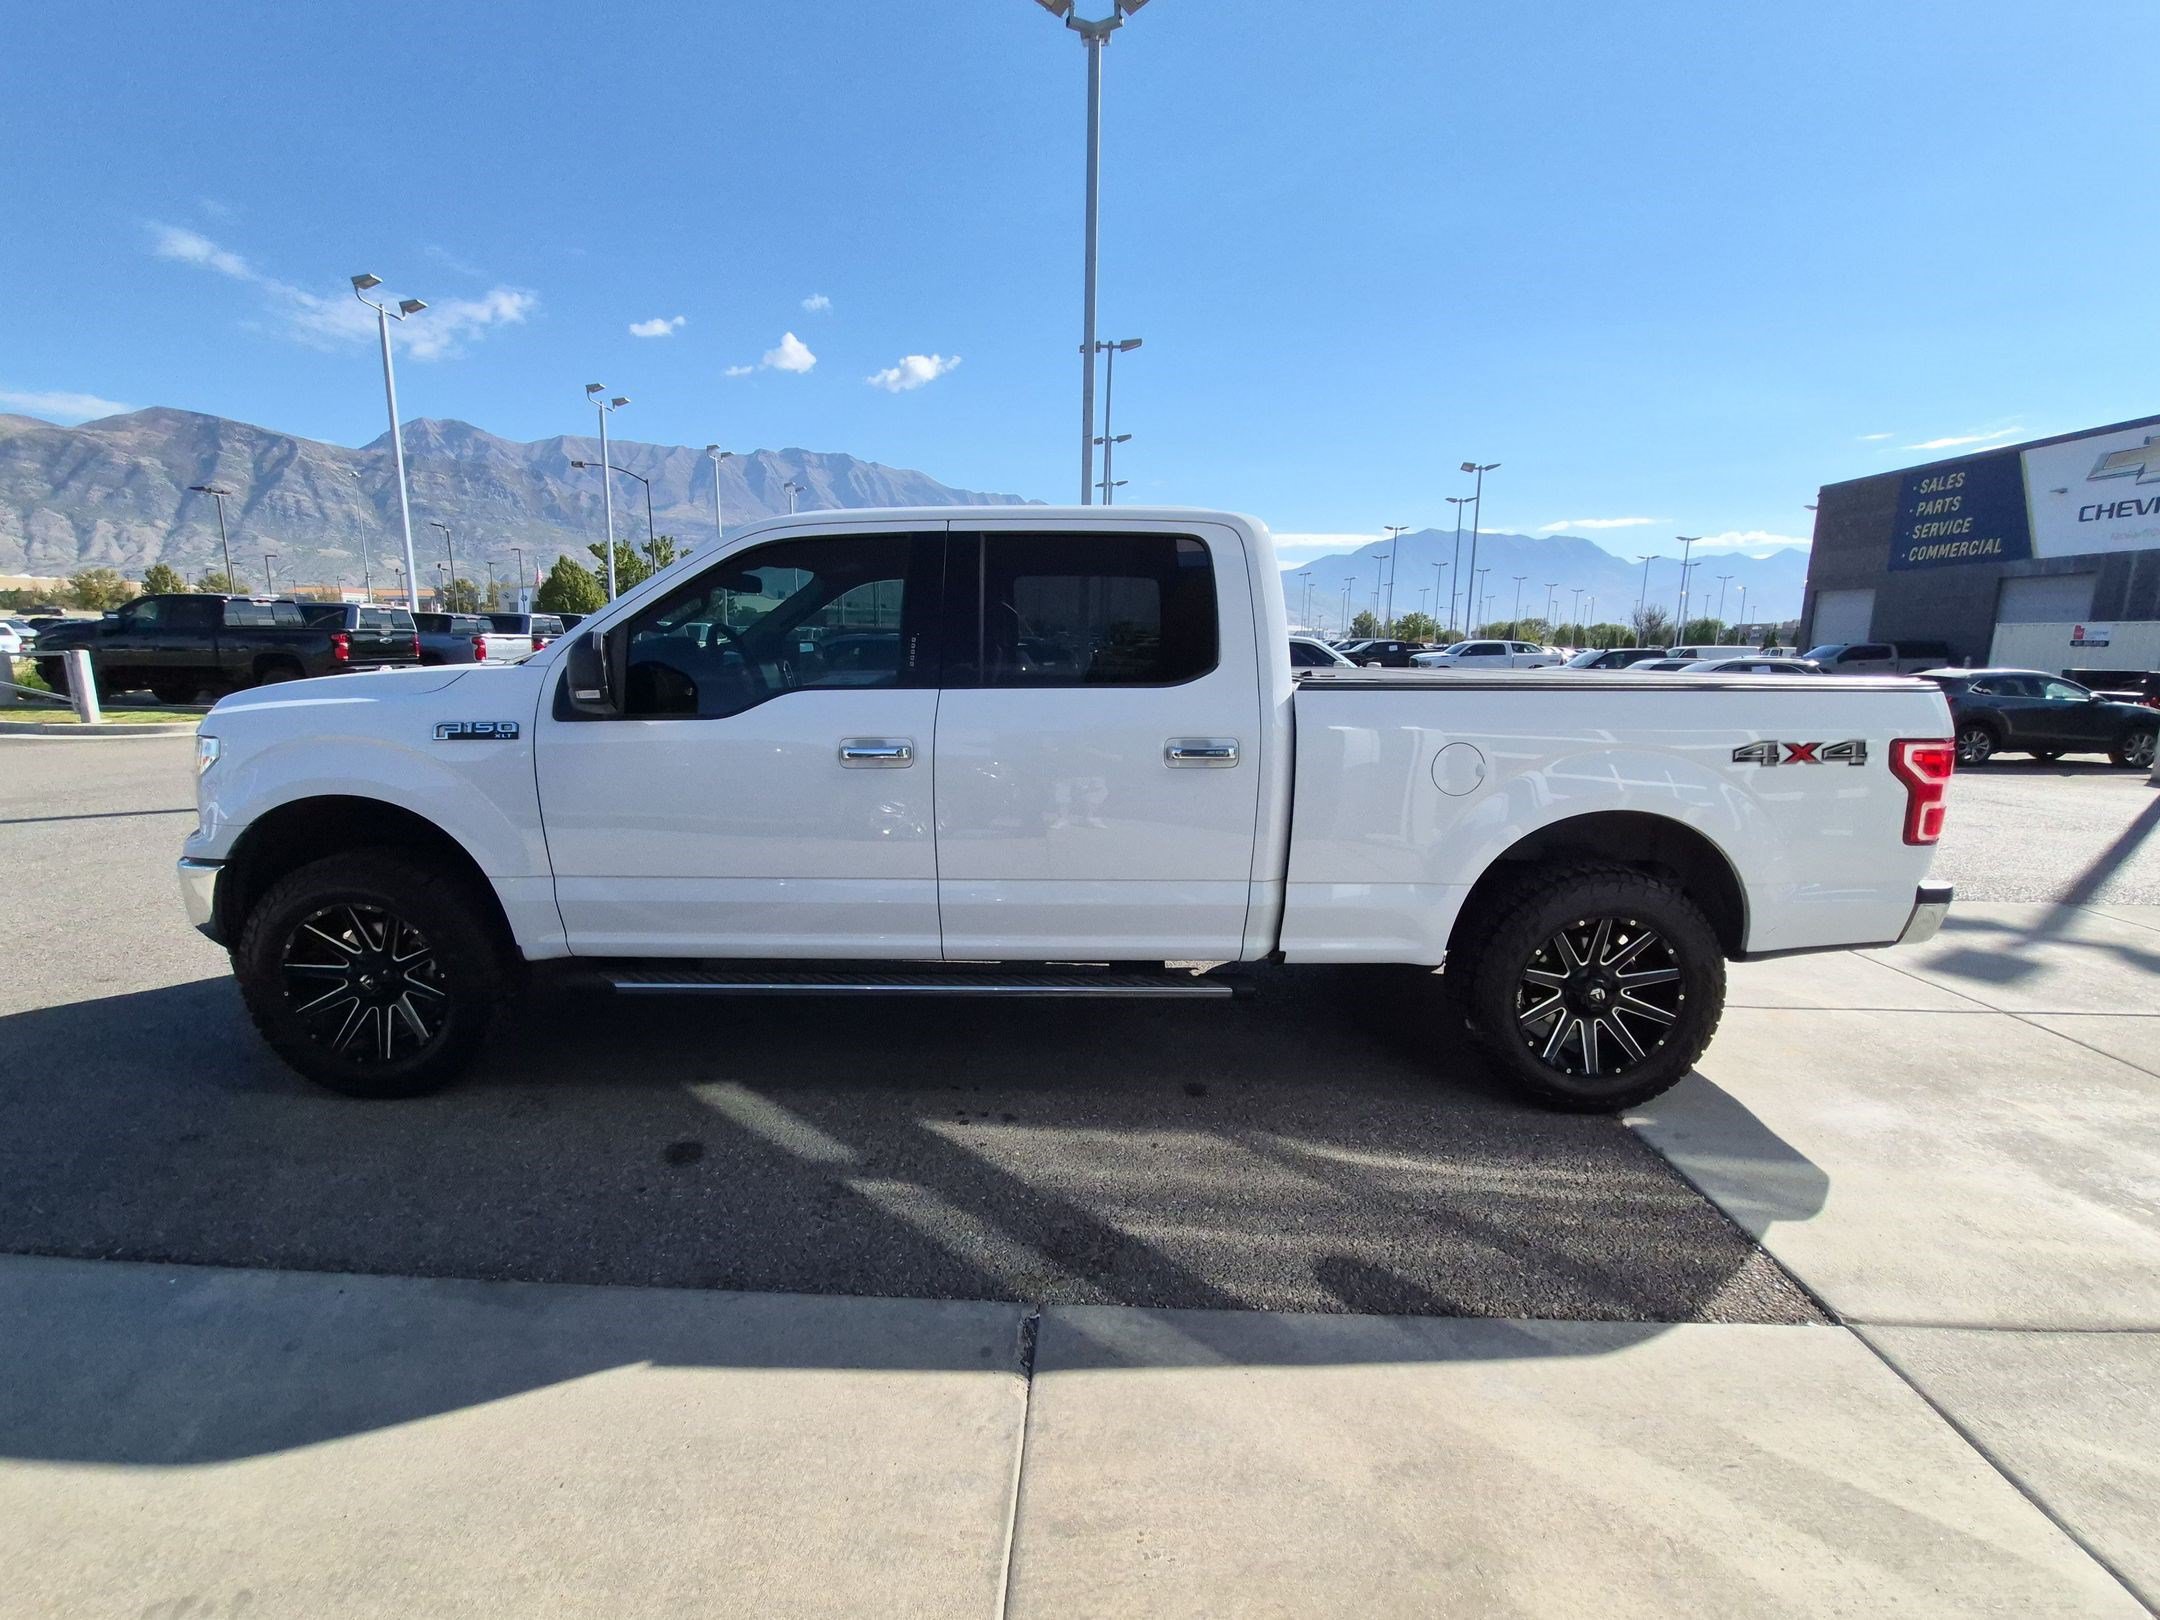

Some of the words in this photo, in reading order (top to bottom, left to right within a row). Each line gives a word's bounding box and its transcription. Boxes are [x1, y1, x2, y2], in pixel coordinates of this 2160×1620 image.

[1920, 472, 1966, 494] SALES
[1915, 496, 1962, 517] PARTS
[1912, 517, 1974, 539] SERVICE
[1908, 538, 2002, 561] COMMERCIAL
